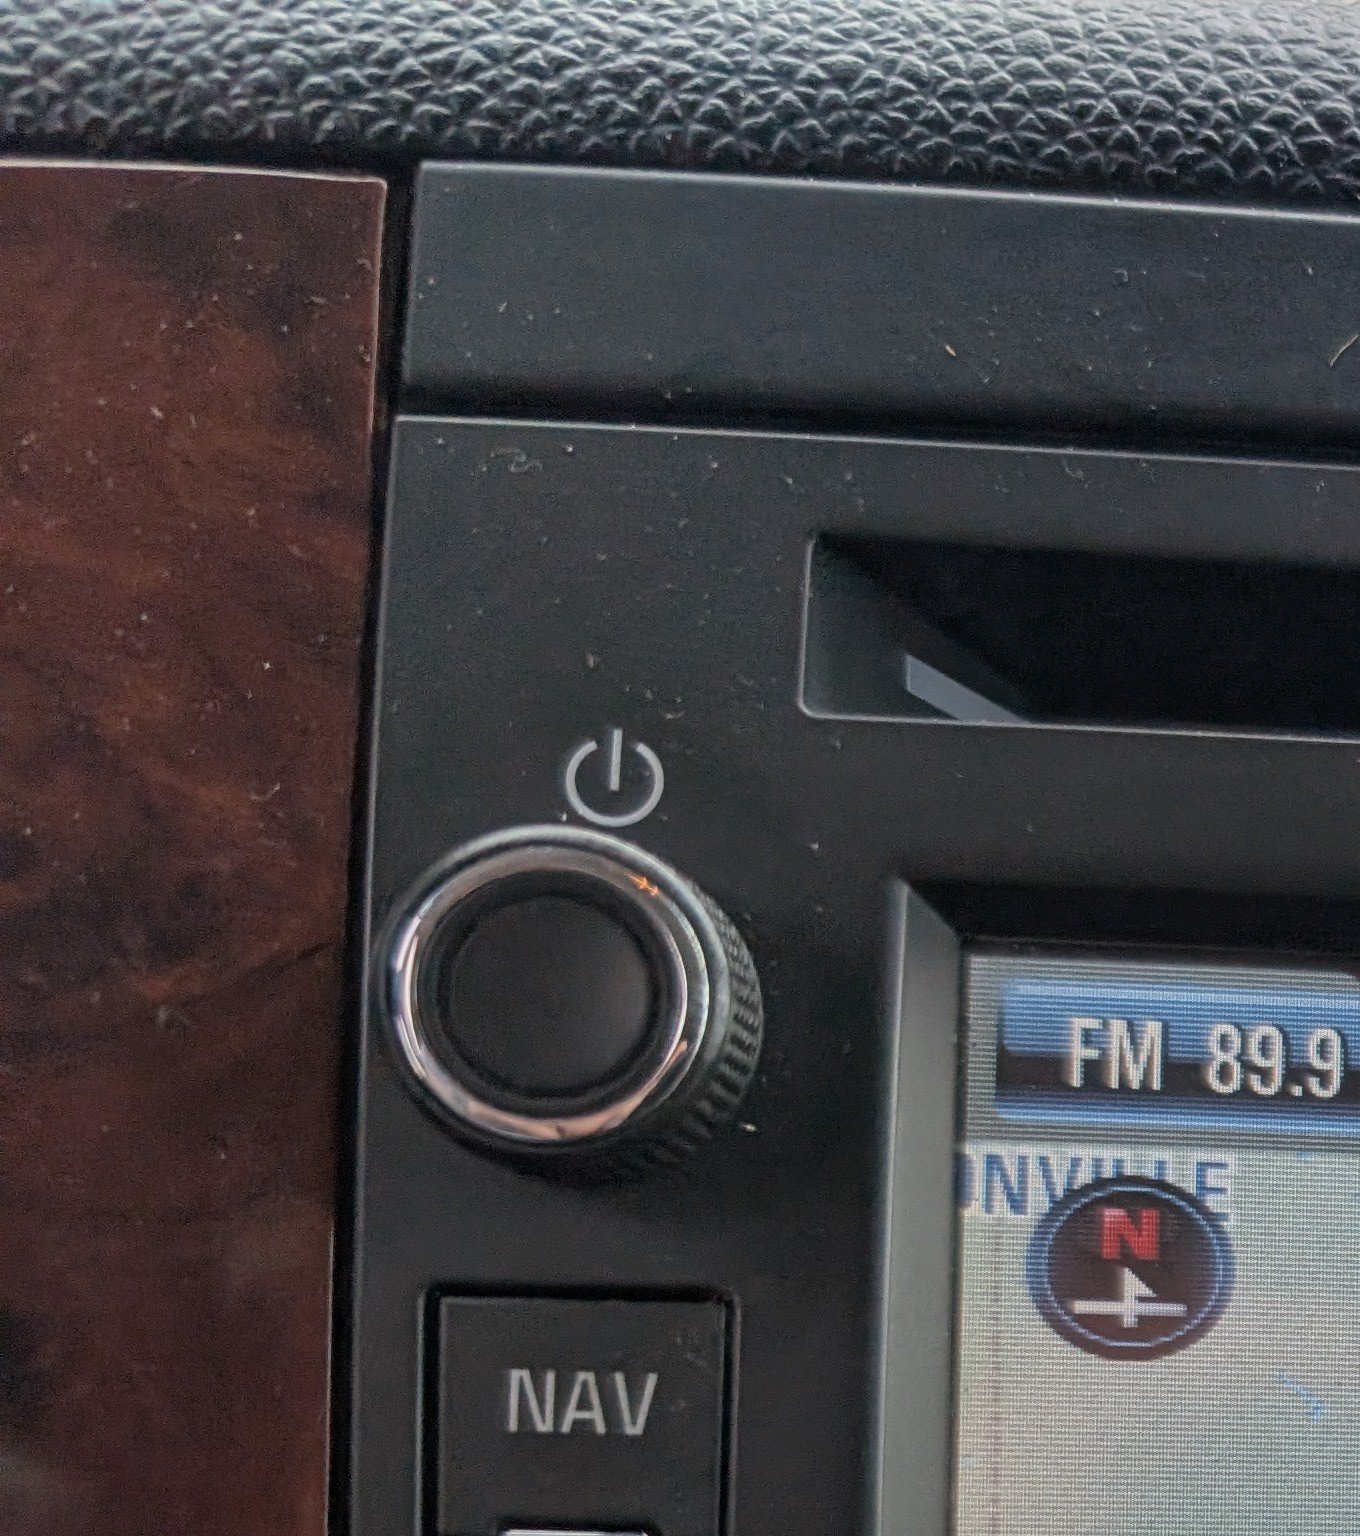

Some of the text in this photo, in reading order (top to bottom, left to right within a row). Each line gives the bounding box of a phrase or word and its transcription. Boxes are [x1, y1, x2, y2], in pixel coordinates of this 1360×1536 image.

[1067, 1018, 1163, 1091] FM
[1208, 1024, 1346, 1098] 89.9
[1101, 1206, 1160, 1261] N
[506, 1368, 657, 1435] NAV
